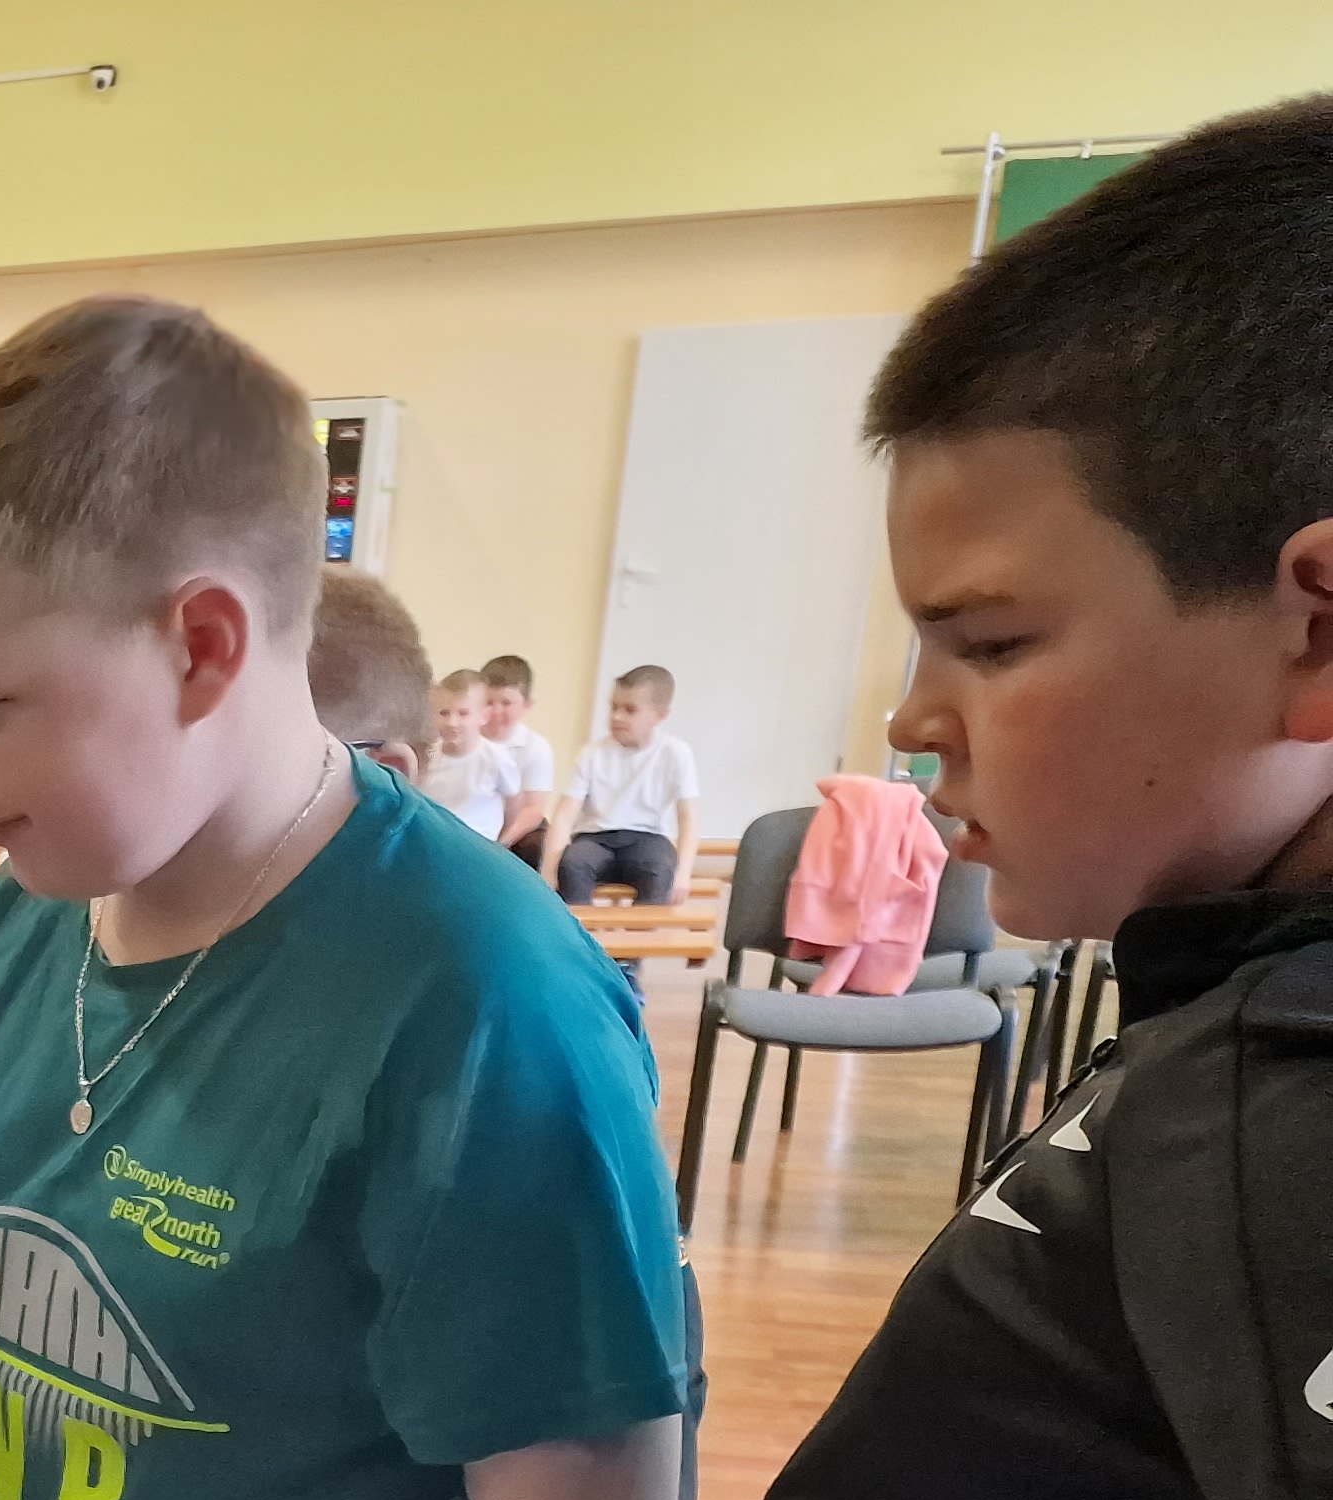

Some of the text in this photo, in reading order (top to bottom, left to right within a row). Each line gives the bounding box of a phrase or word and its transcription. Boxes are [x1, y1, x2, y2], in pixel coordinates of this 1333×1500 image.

[123, 1159, 236, 1212] Simplyhealth
[110, 1196, 221, 1248] great north
[180, 1248, 218, 1269] run
